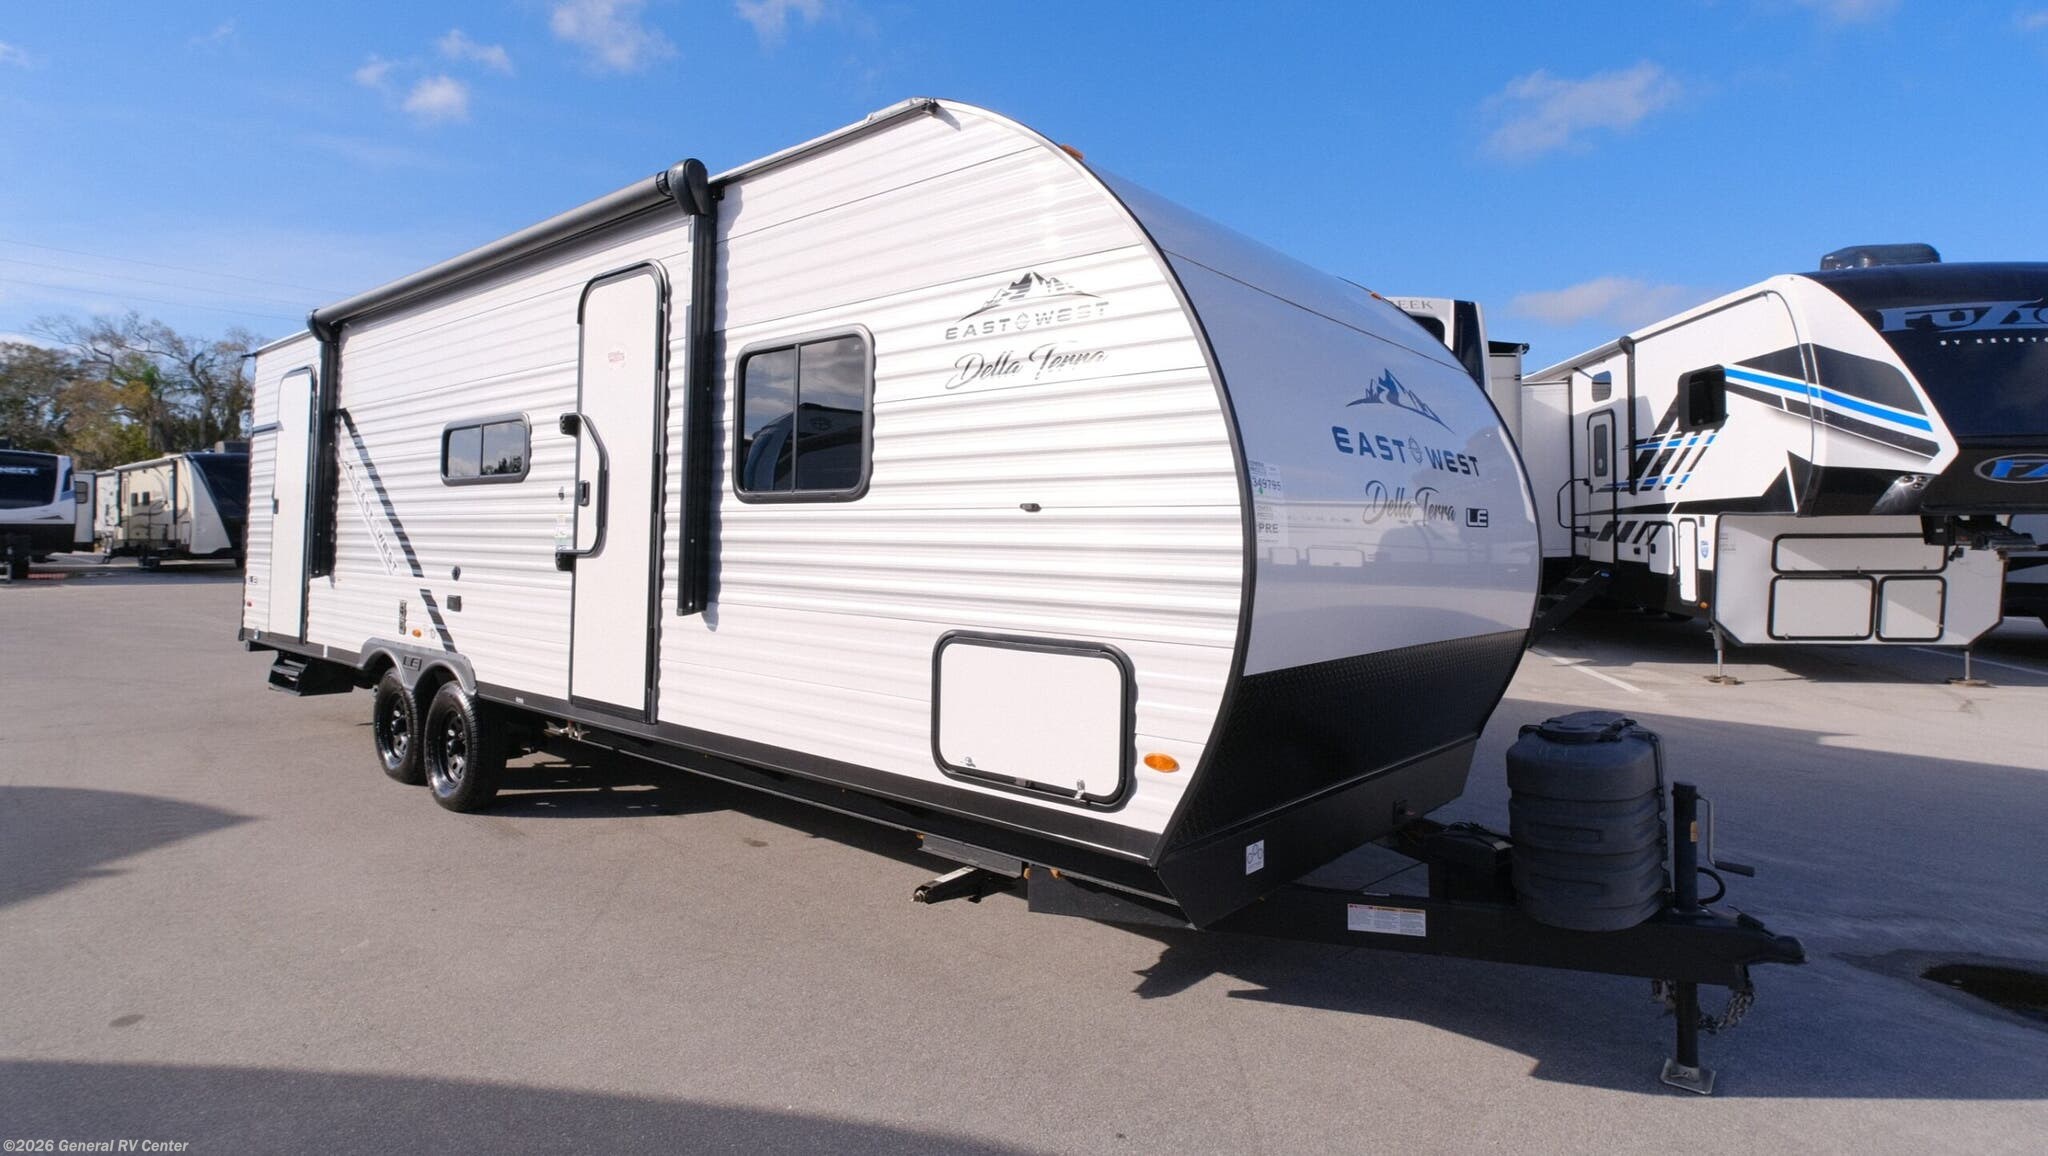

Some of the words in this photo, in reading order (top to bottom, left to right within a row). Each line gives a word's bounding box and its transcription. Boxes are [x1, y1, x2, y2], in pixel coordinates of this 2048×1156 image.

[945, 318, 1011, 340] EAST
[1035, 301, 1109, 326] WEST
[945, 350, 1022, 389] Della
[1331, 425, 1406, 464] EAST
[1425, 445, 1480, 477] WEST
[1362, 479, 1414, 525] Della
[1415, 486, 1457, 527] Terra
[1465, 508, 1489, 527] LE
[1258, 522, 1279, 534] PRE
